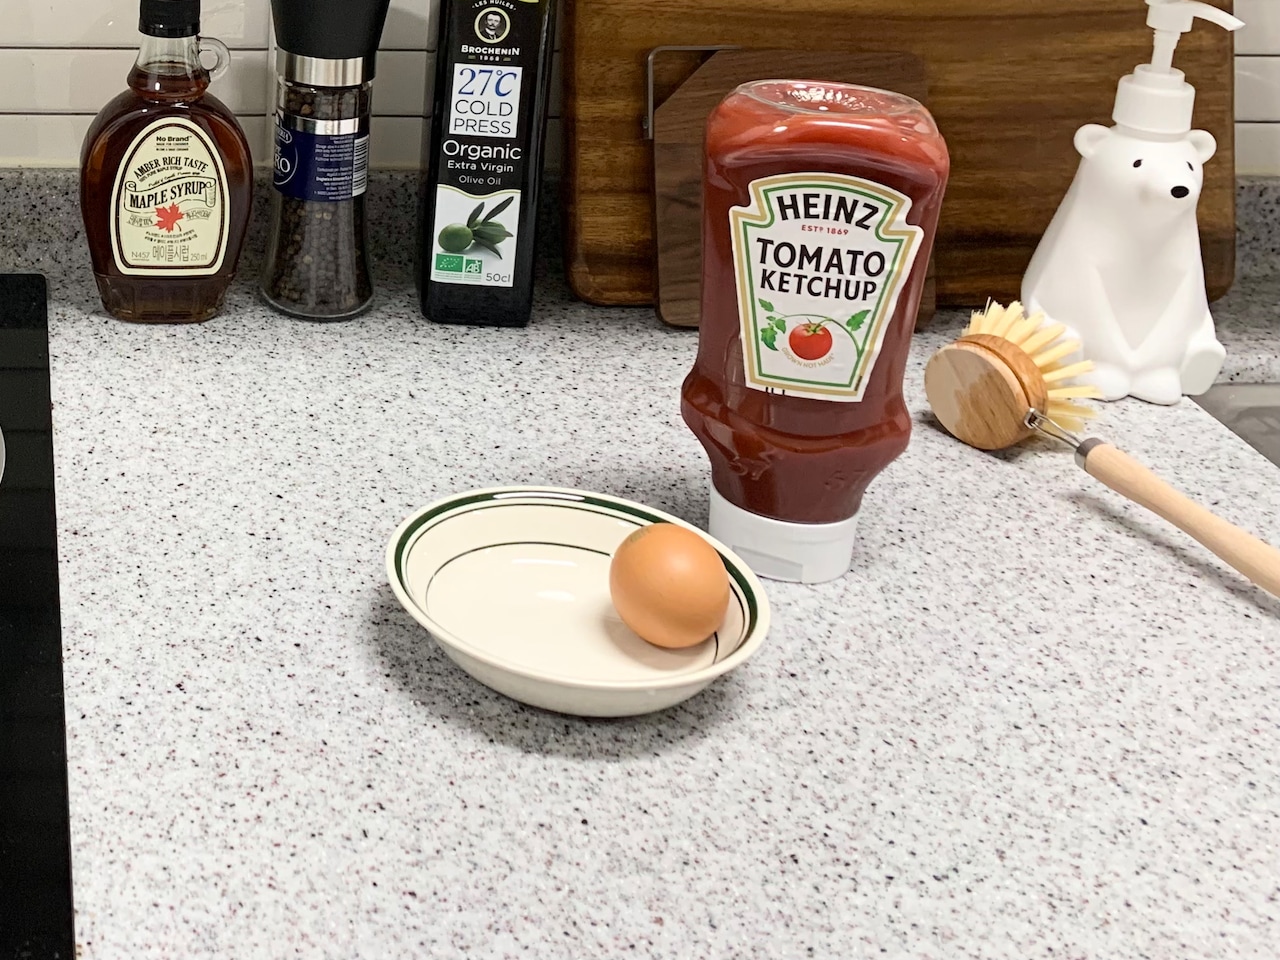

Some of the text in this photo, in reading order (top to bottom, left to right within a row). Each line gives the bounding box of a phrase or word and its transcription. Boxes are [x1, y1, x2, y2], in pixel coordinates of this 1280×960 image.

[474, 0, 488, 8] LES
[461, 44, 520, 56] BROCHENIN
[455, 99, 513, 117] COLD
[453, 118, 511, 135] PRESS
[443, 139, 522, 160] Organic
[133, 158, 161, 180] AMBER
[162, 156, 182, 166] RICH
[183, 156, 209, 173] TASTE
[447, 160, 514, 174] Extra Virgin
[458, 175, 502, 186] Olive Oil
[129, 181, 207, 209] MAPLE SYRUP
[776, 193, 879, 231] HEINZ
[826, 227, 849, 236] 1869
[152, 244, 190, 262] 메이플시럽
[756, 237, 886, 277] TOMATO
[760, 268, 877, 301] KETCHUP
